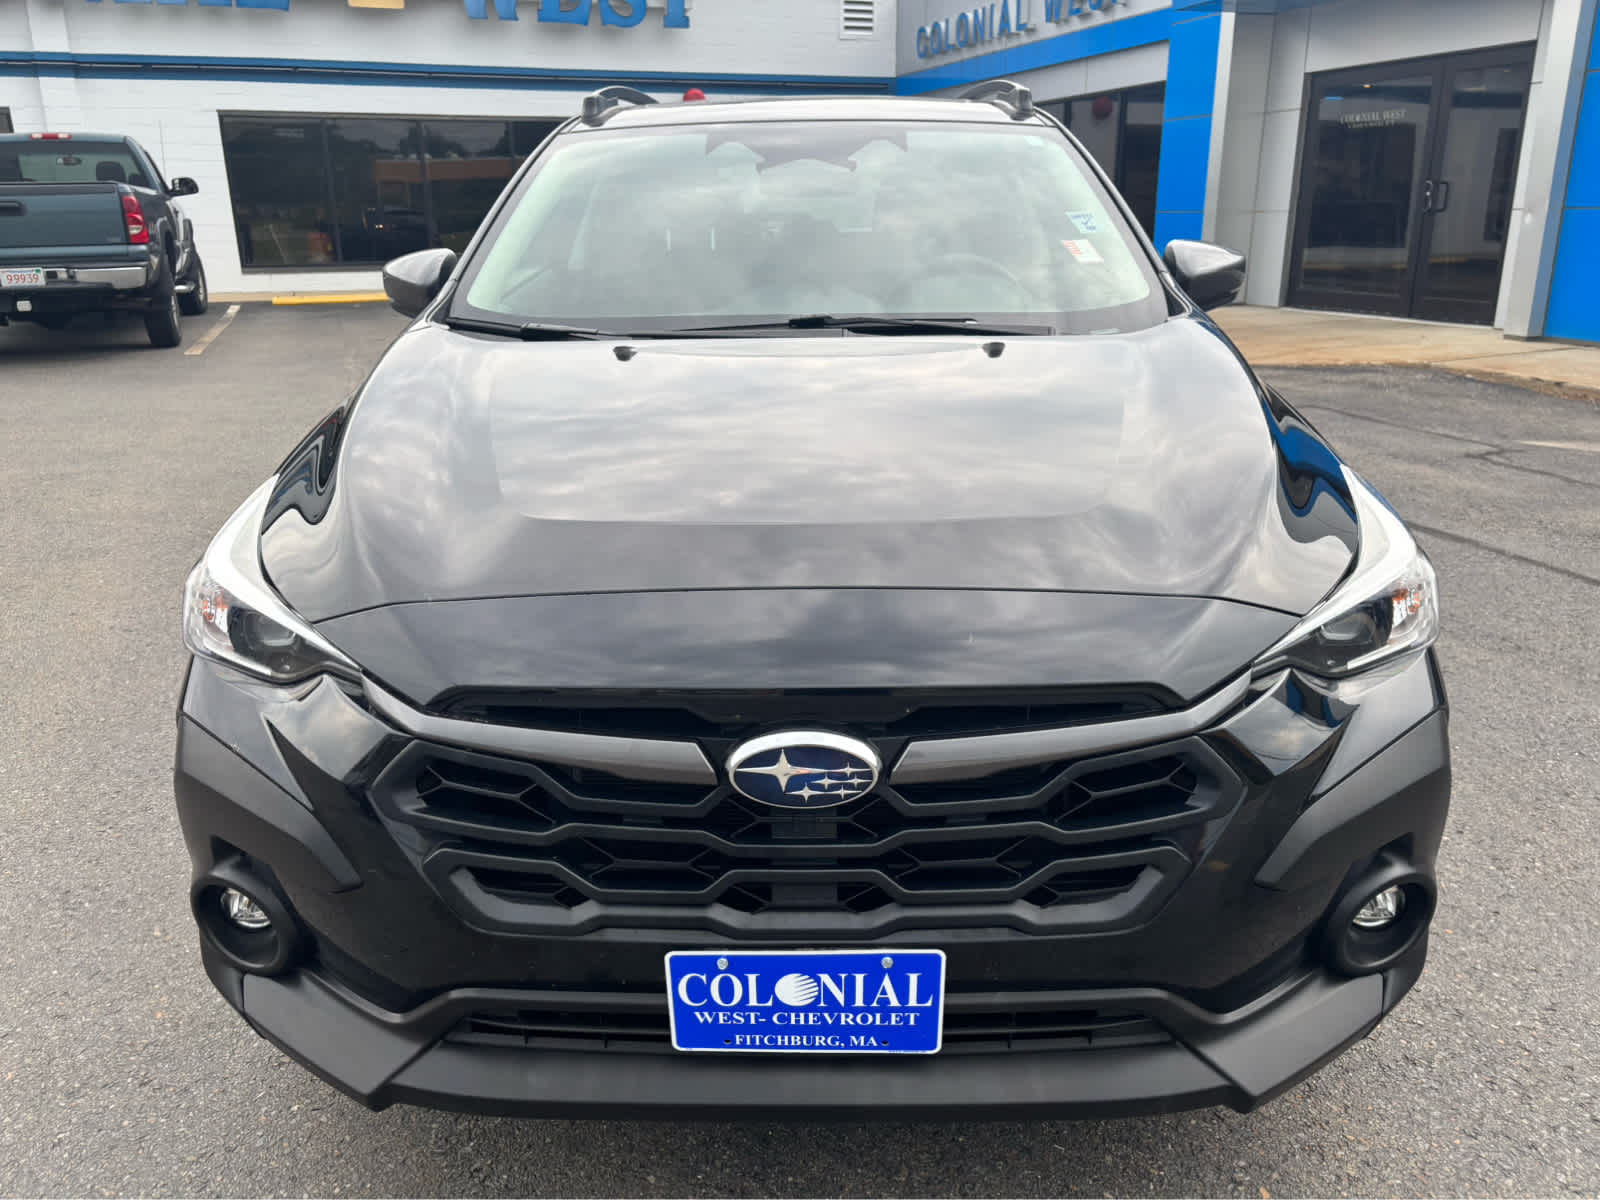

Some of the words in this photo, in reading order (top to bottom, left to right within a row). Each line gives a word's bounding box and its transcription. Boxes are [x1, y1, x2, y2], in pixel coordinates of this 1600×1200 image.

[916, 0, 1028, 58] COLONIAL
[6, 273, 40, 284] 99939
[772, 1011, 920, 1026] CHEVROLET
[735, 1034, 845, 1048] FITCHBURG,
[849, 1035, 878, 1047] MA
